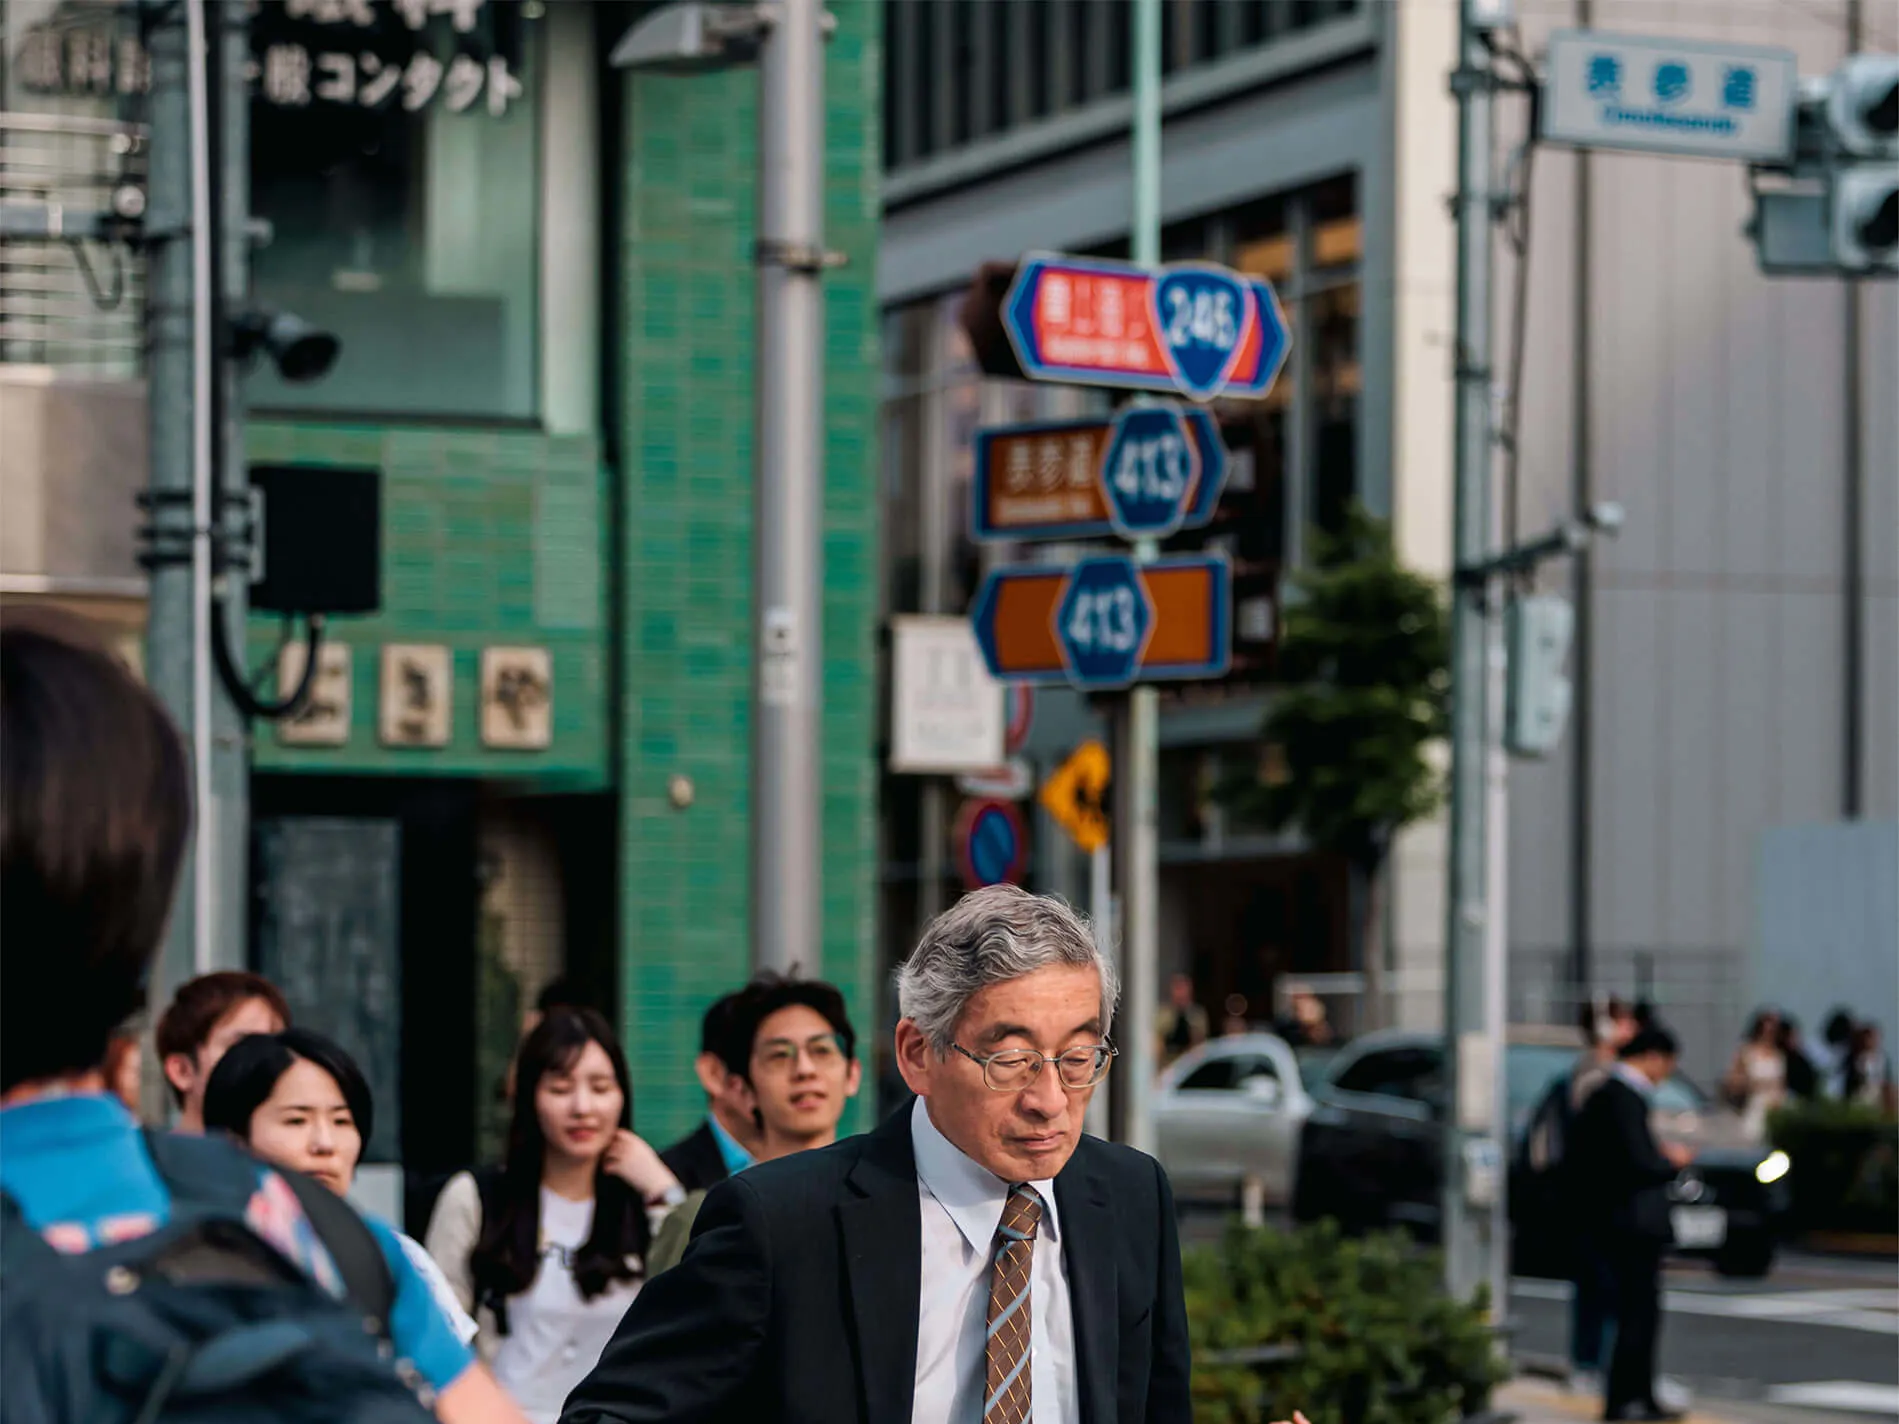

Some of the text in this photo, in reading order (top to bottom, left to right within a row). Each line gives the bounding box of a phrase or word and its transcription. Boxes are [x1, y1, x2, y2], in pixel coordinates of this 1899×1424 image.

[245, 43, 522, 116] 般コンタクト
[1585, 55, 1757, 110] 表参道
[1113, 432, 1185, 500] 413
[1068, 586, 1136, 653] 413
